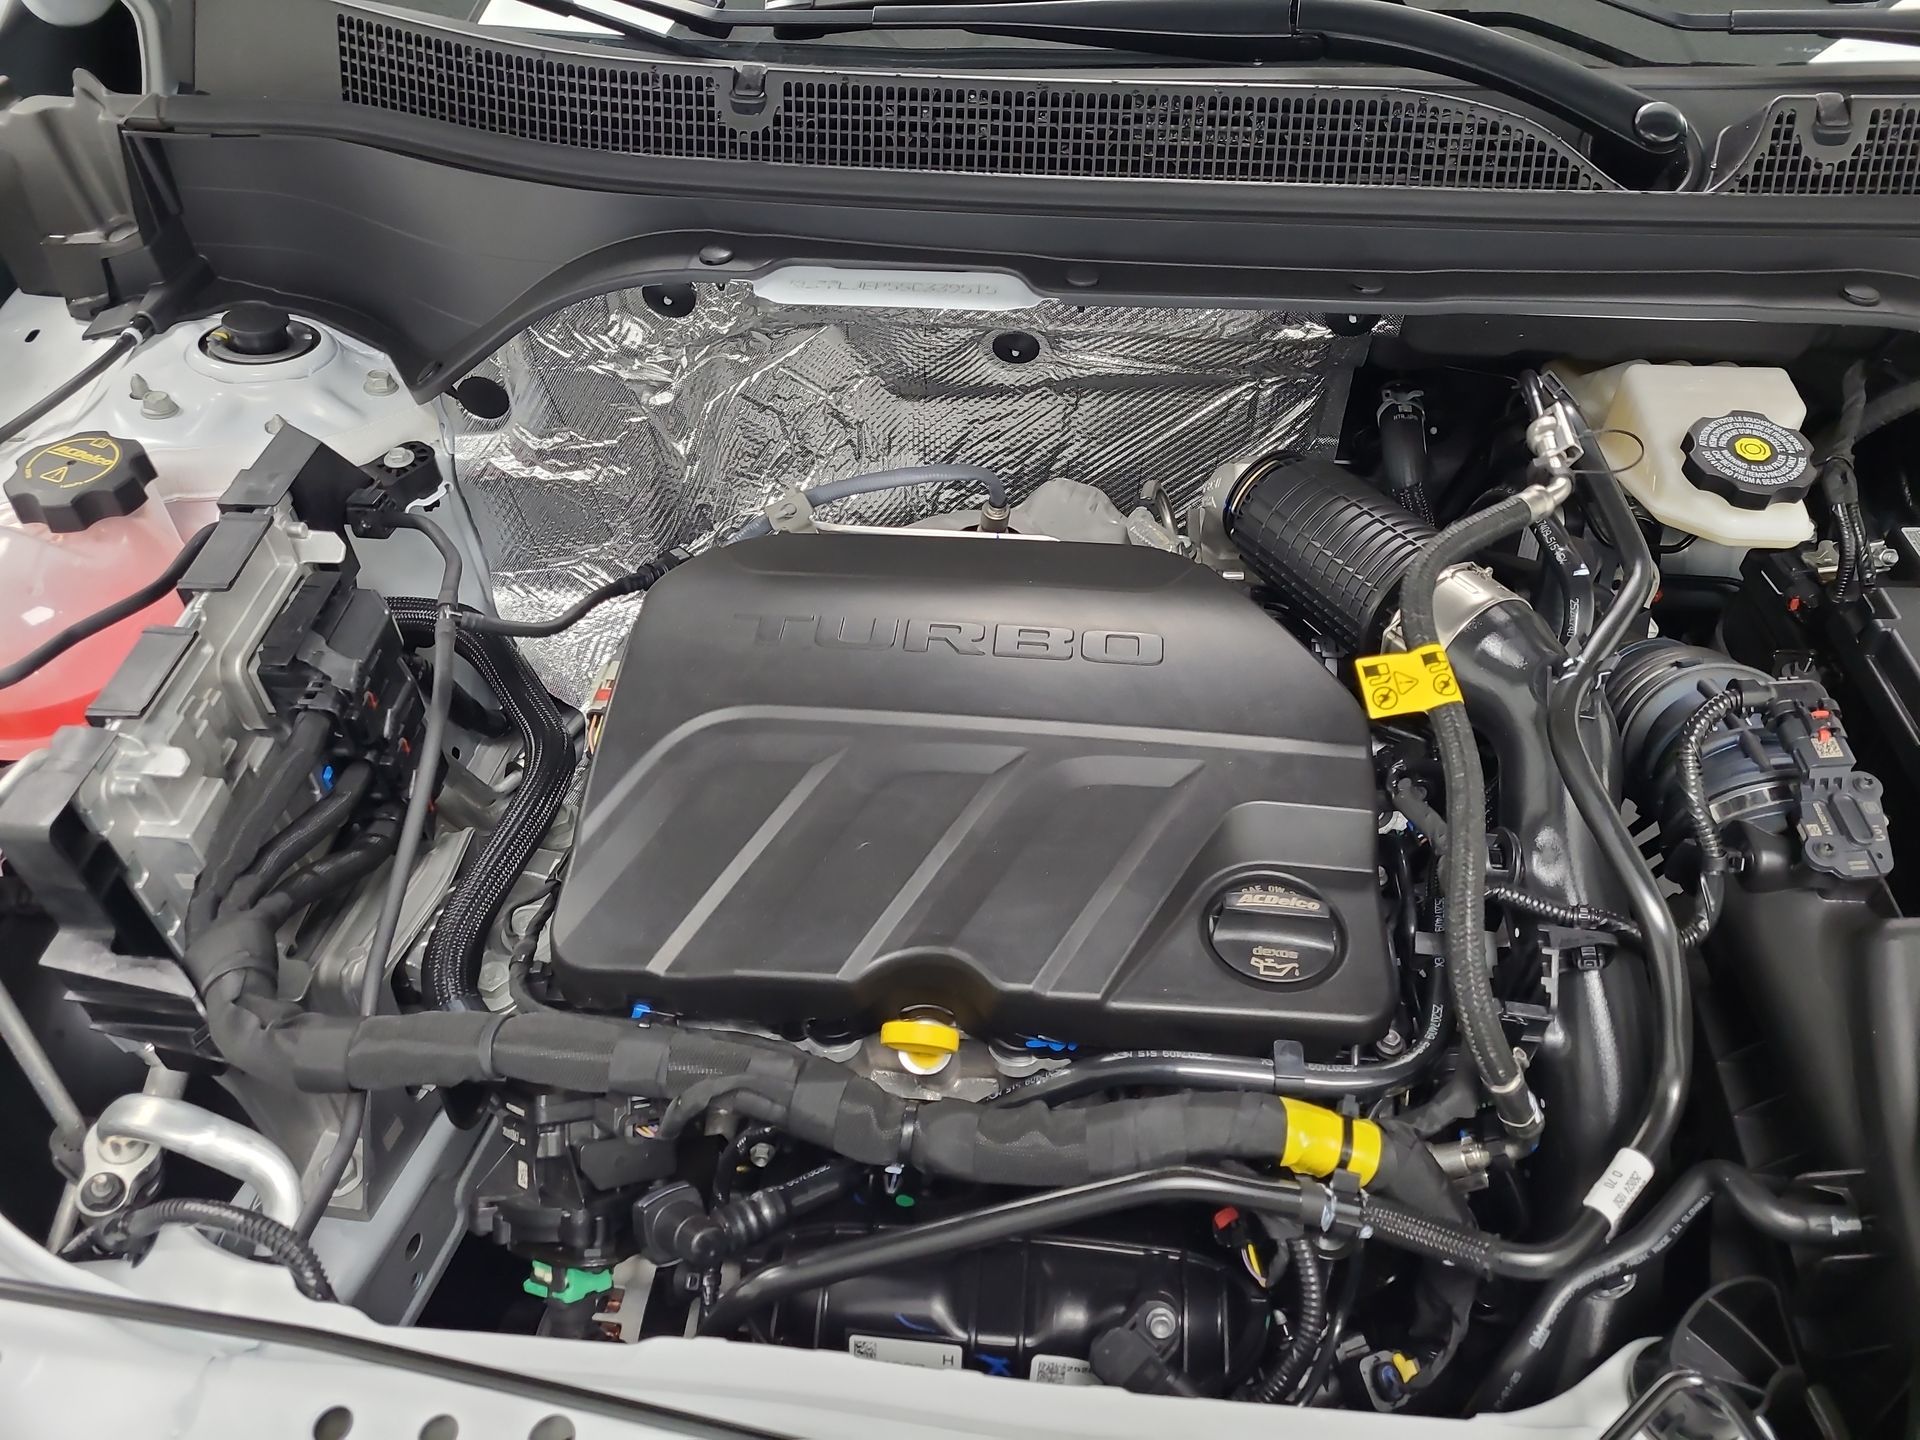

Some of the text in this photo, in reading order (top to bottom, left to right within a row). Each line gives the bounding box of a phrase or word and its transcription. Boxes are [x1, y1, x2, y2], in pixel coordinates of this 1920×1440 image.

[1713, 463, 1734, 477] FLUID
[1733, 473, 1754, 484] FROM
[734, 613, 1164, 667] TURBO
[1237, 893, 1320, 911] ACDelco
[1252, 946, 1299, 959] dexos
[942, 1354, 954, 1365] H
